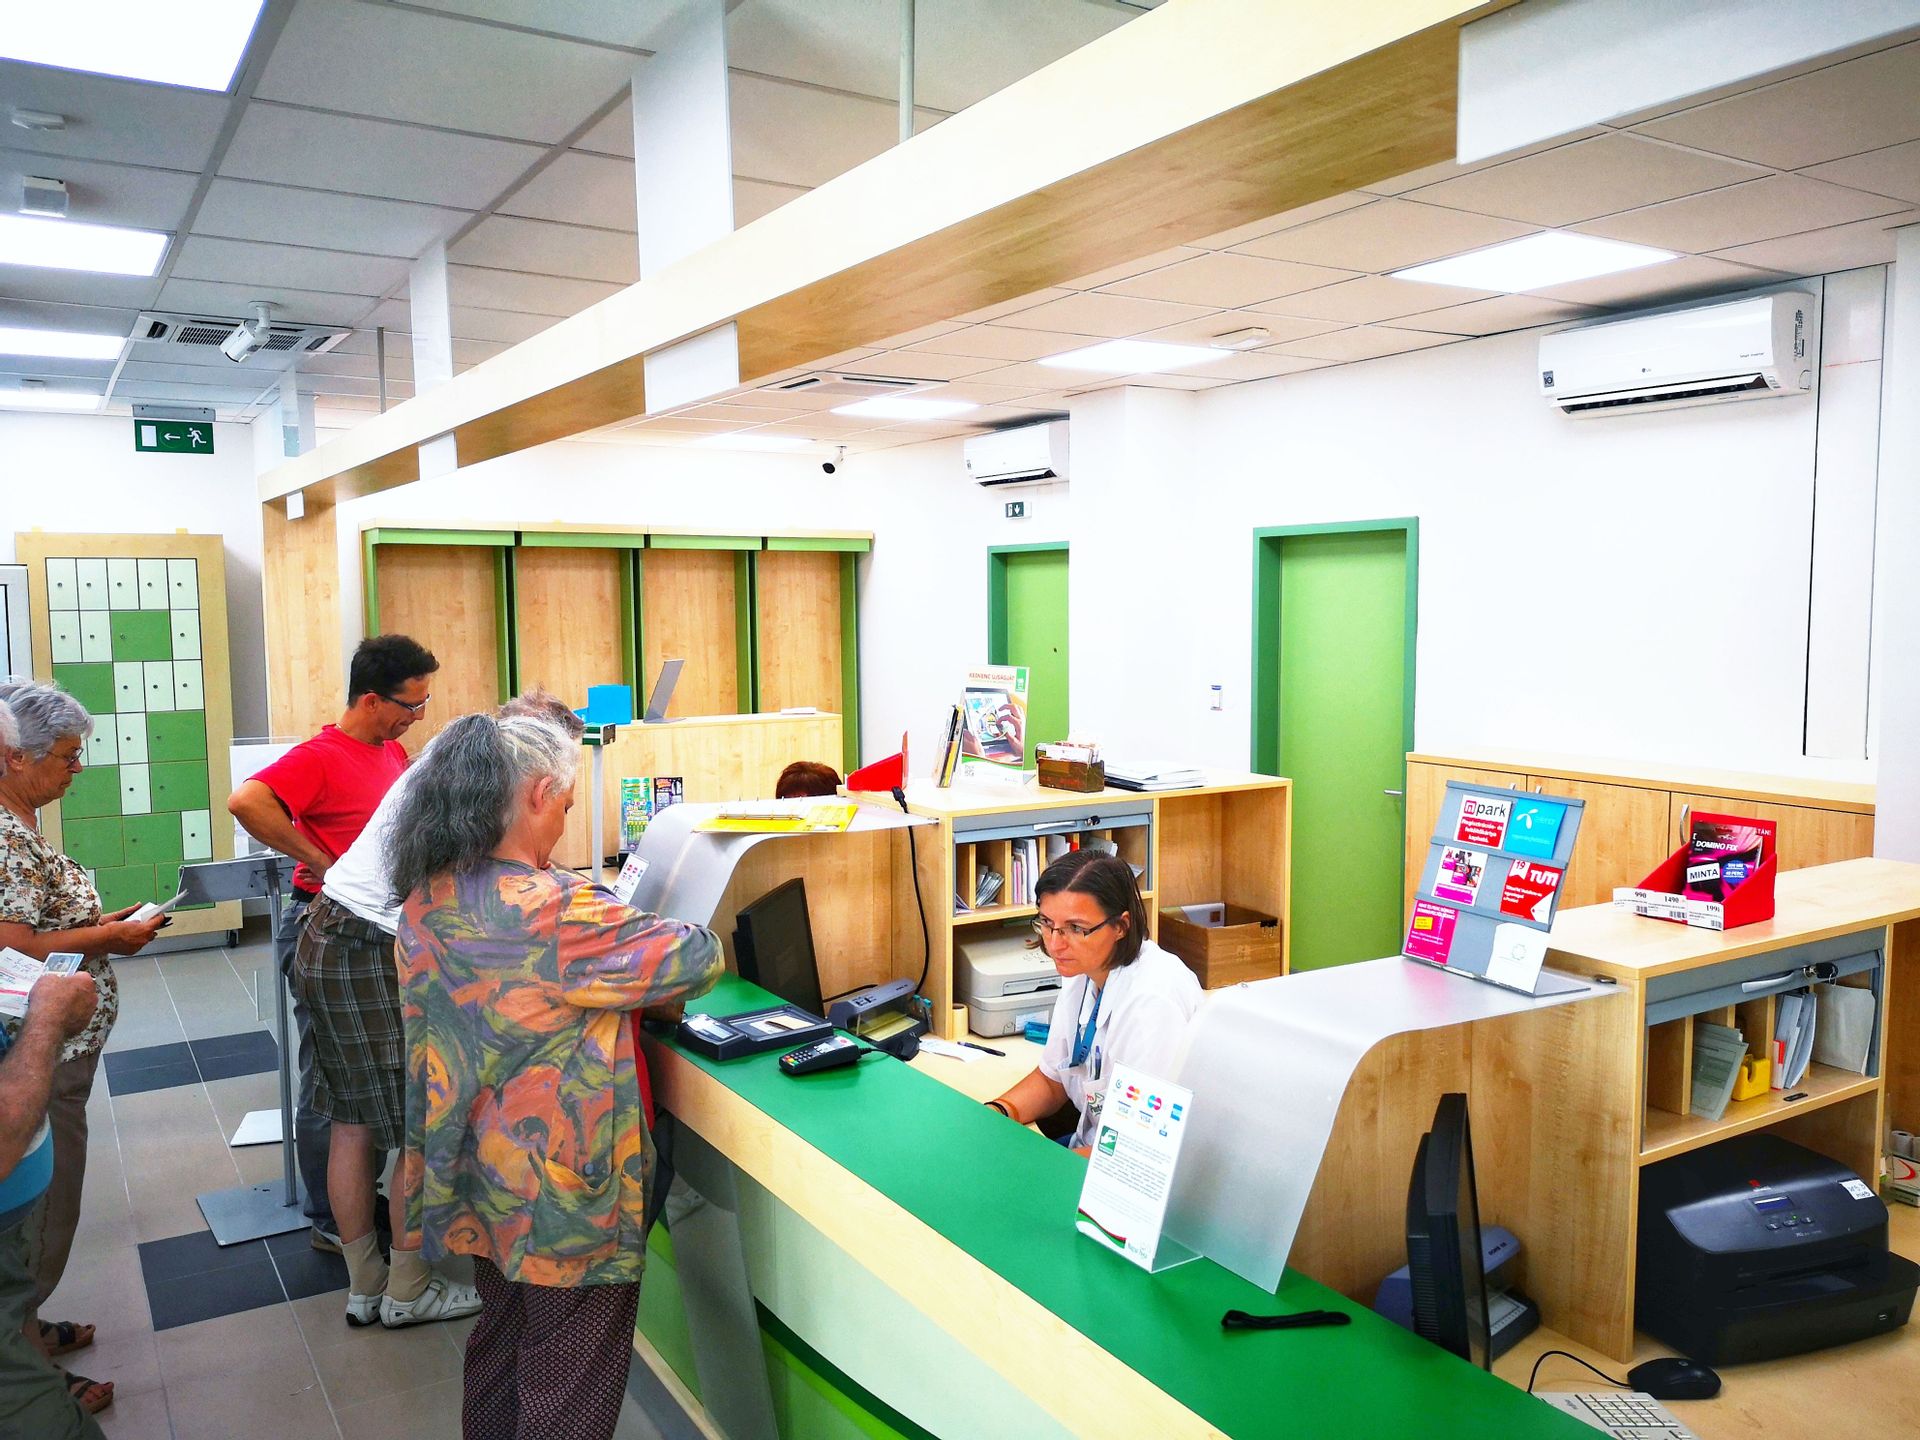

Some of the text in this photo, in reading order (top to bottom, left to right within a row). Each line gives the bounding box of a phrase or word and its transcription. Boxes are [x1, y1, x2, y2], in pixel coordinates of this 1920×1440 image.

[1695, 840, 1726, 850] DOMINO
[1516, 861, 1526, 869] 19
[1689, 869, 1719, 880] MINTA
[1634, 891, 1647, 899] 990
[1664, 895, 1680, 903] 1490
